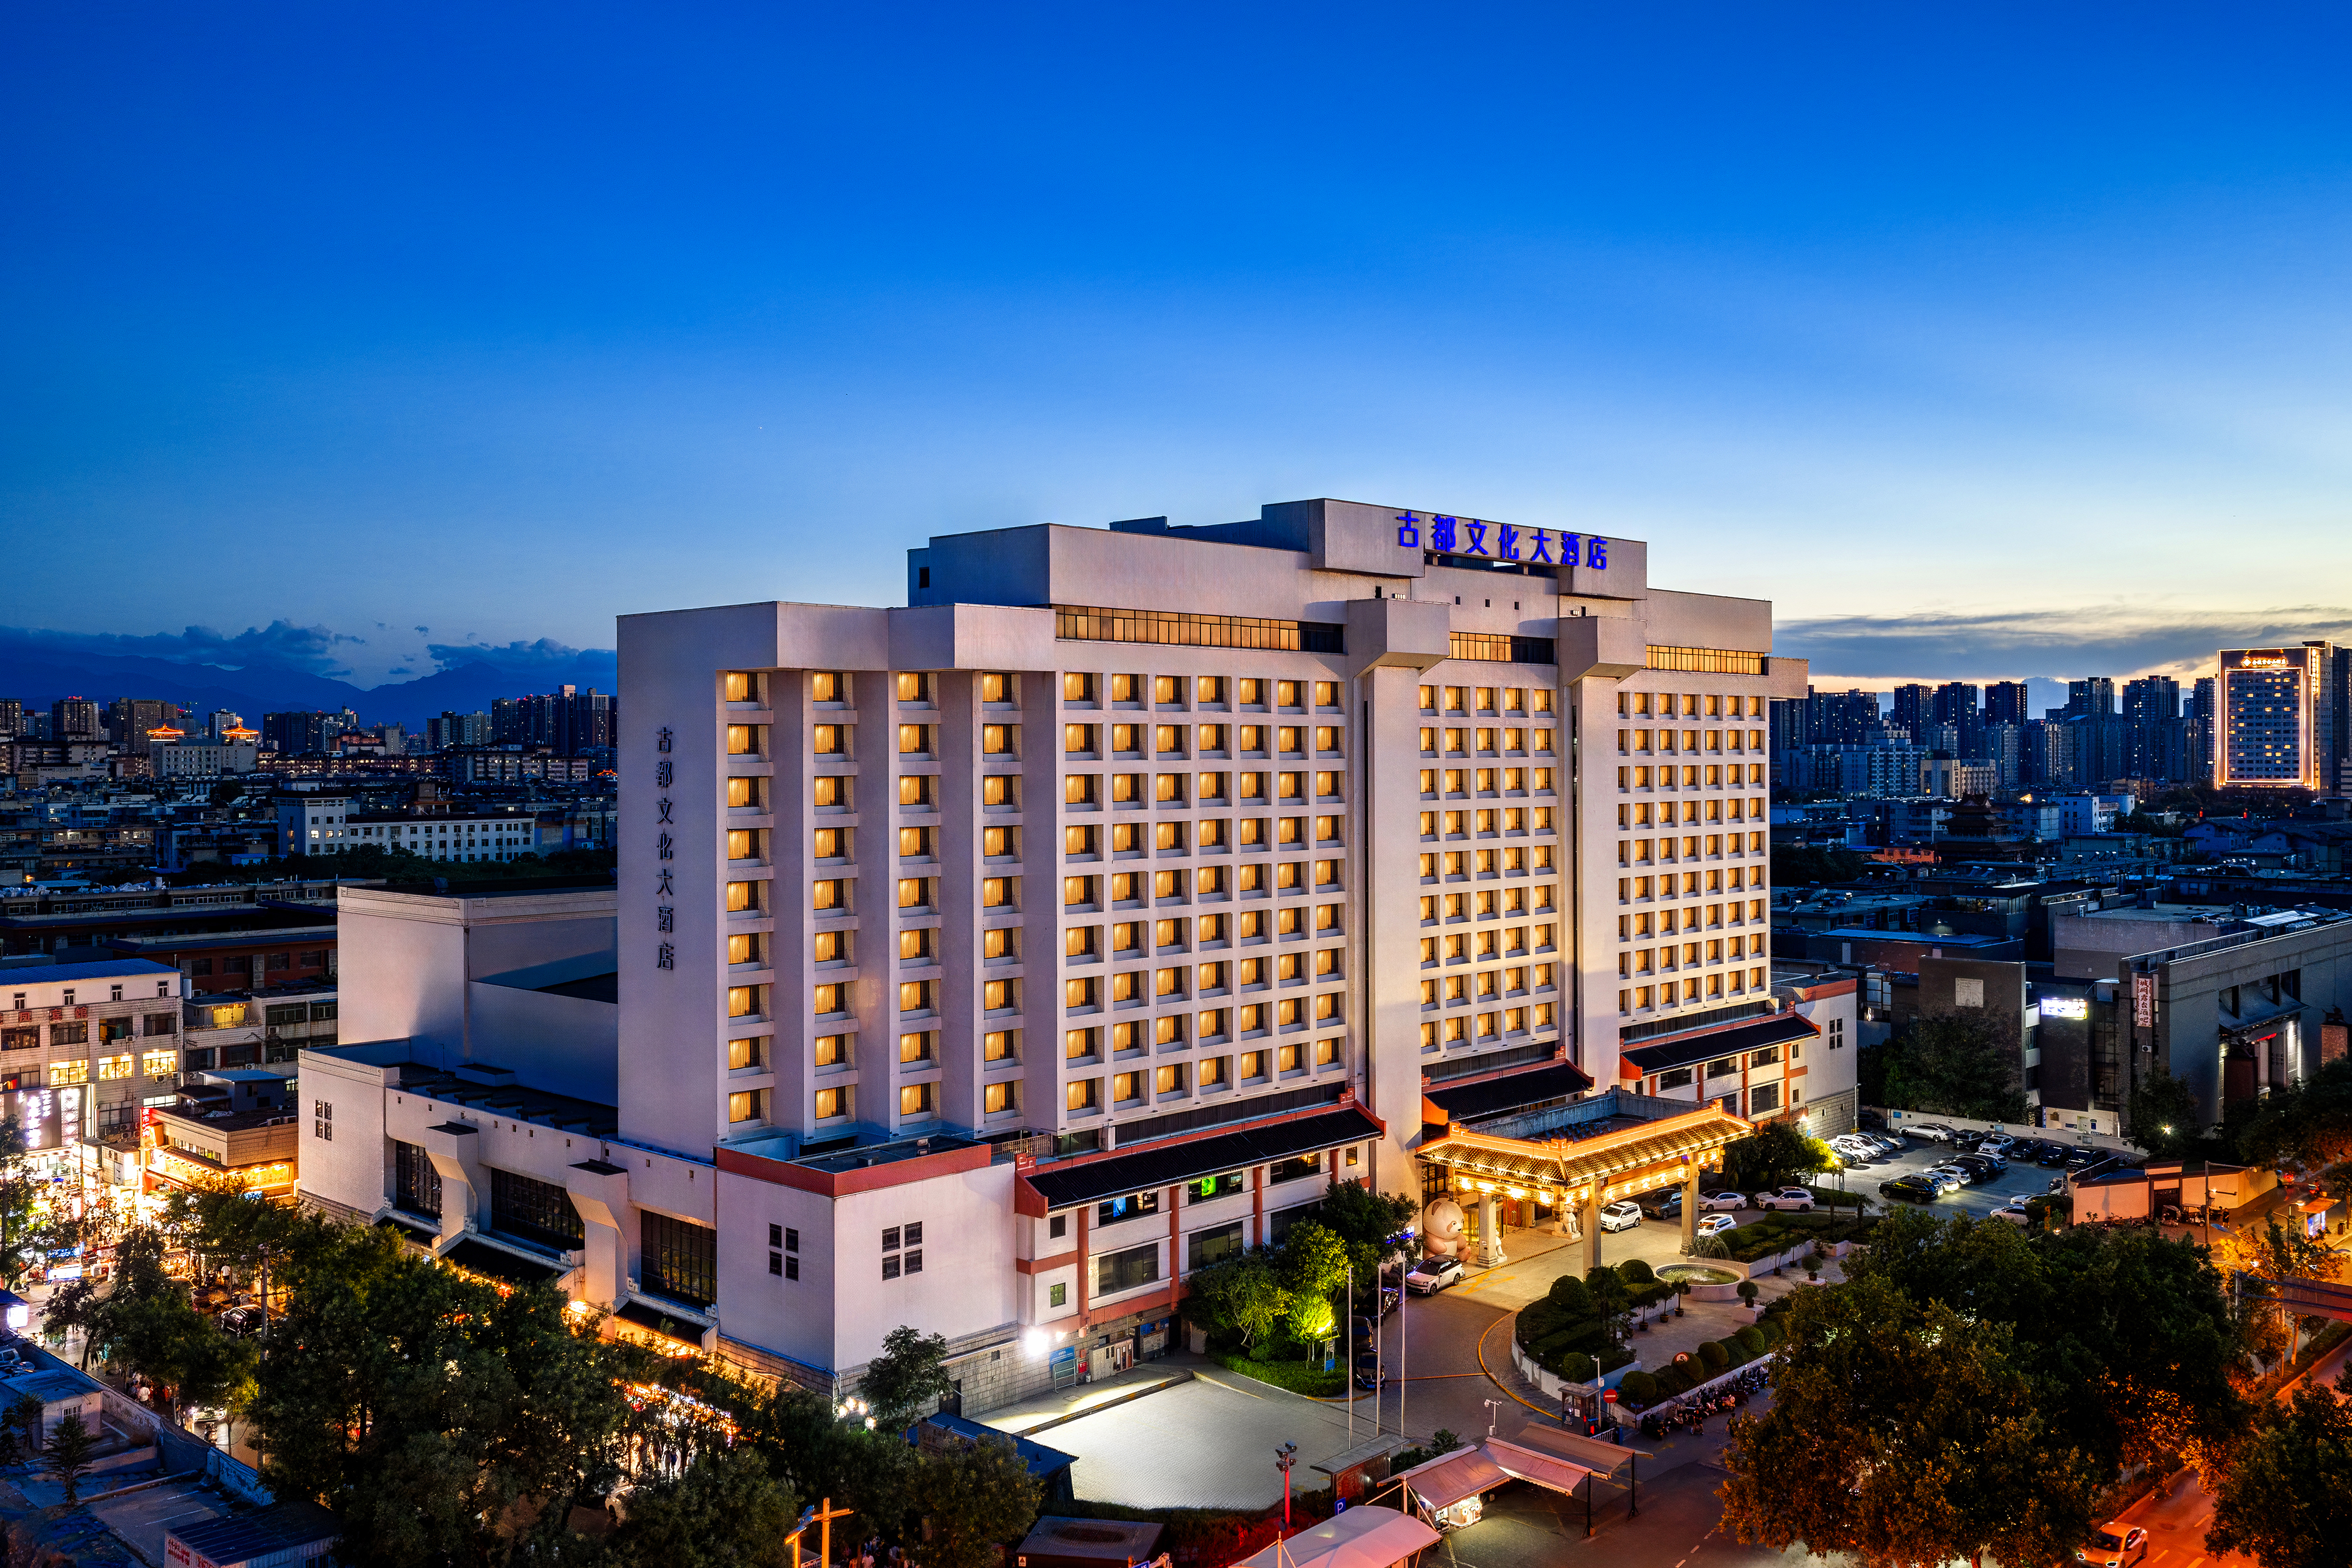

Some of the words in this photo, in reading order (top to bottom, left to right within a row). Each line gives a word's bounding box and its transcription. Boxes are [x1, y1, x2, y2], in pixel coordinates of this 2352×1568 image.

[1397, 511, 1608, 570] 古都文化大酒店
[656, 727, 674, 970] 古都文化大酒店
[1337, 1502, 1344, 1515] P
